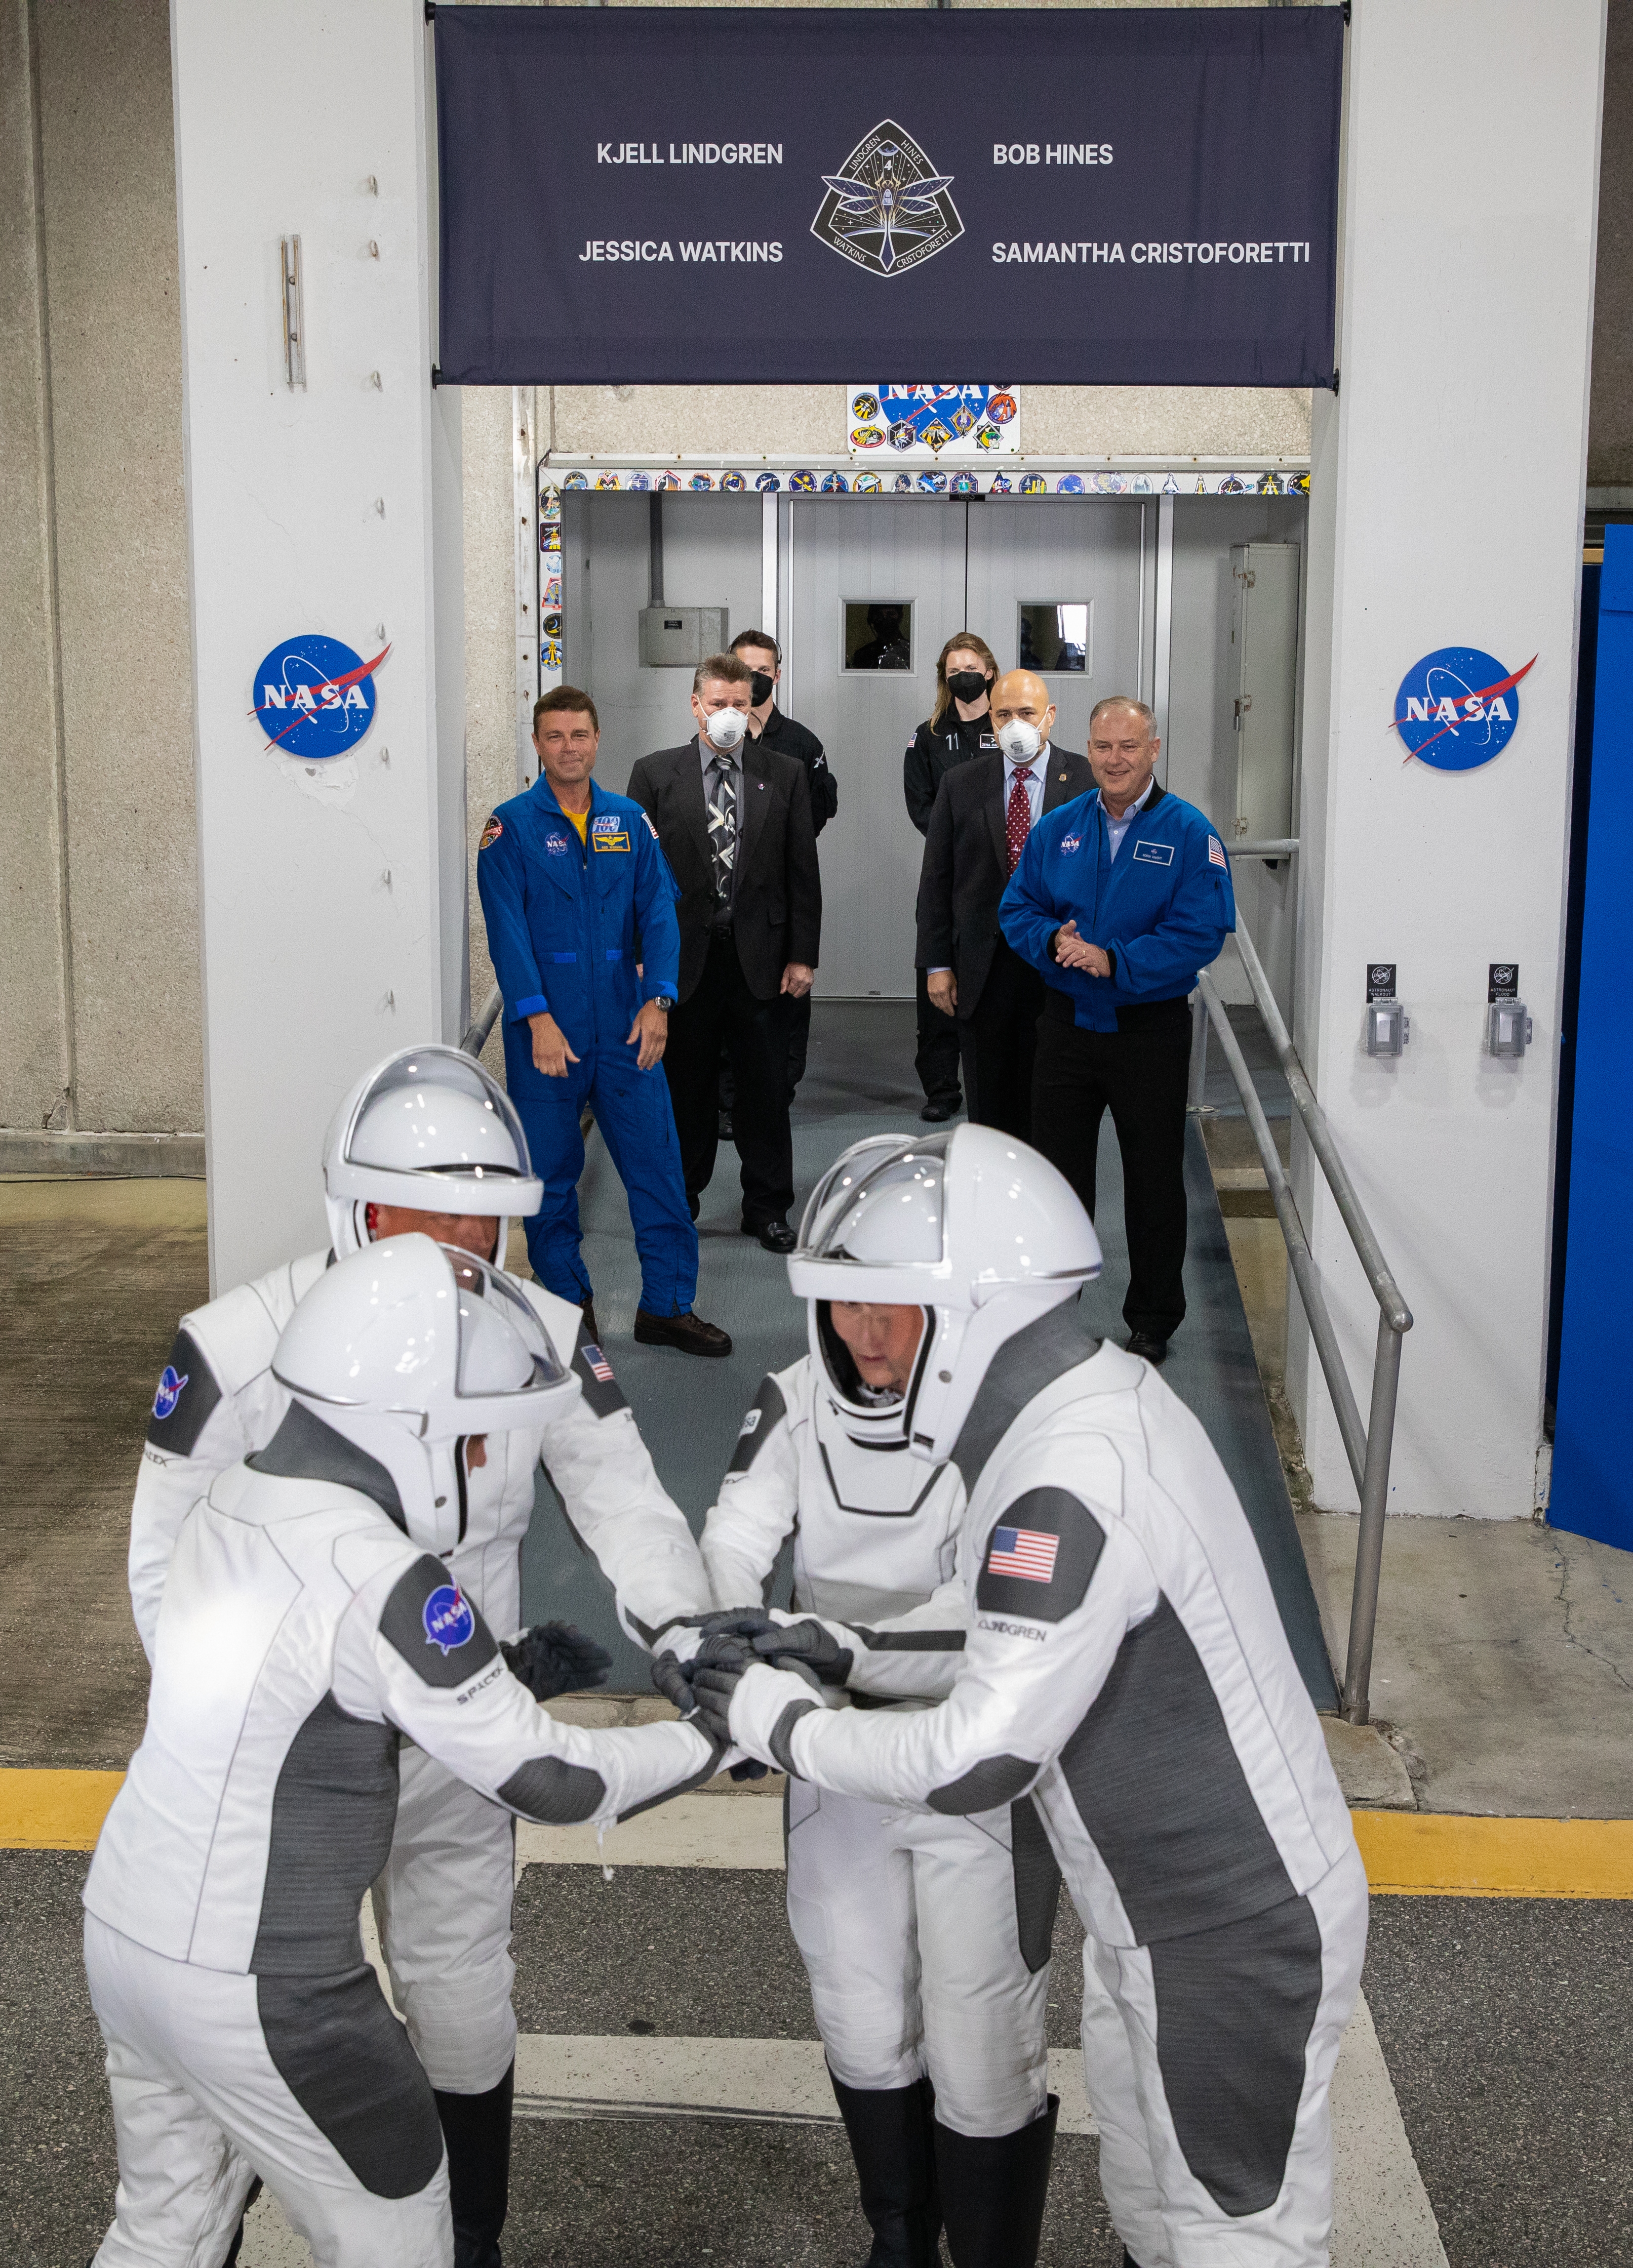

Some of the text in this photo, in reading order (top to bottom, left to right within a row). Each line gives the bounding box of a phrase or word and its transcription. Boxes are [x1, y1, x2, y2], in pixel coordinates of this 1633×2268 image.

[598, 143, 782, 164] KJELL LINDGREN
[849, 136, 881, 171] LINDGREN
[901, 140, 923, 165] HINES
[994, 144, 1112, 164] BOB HINES
[884, 160, 892, 171] 4
[579, 241, 782, 262] JESSICA WATKINS
[833, 236, 867, 262] WATKINS
[896, 230, 952, 268] CRISTOFORETTI
[992, 242, 1309, 263] SAMANTHA CRISTOFORETTI
[888, 385, 984, 399] NASA
[263, 685, 370, 709] NASA
[1405, 696, 1512, 722] NASA
[946, 733, 959, 750] 11
